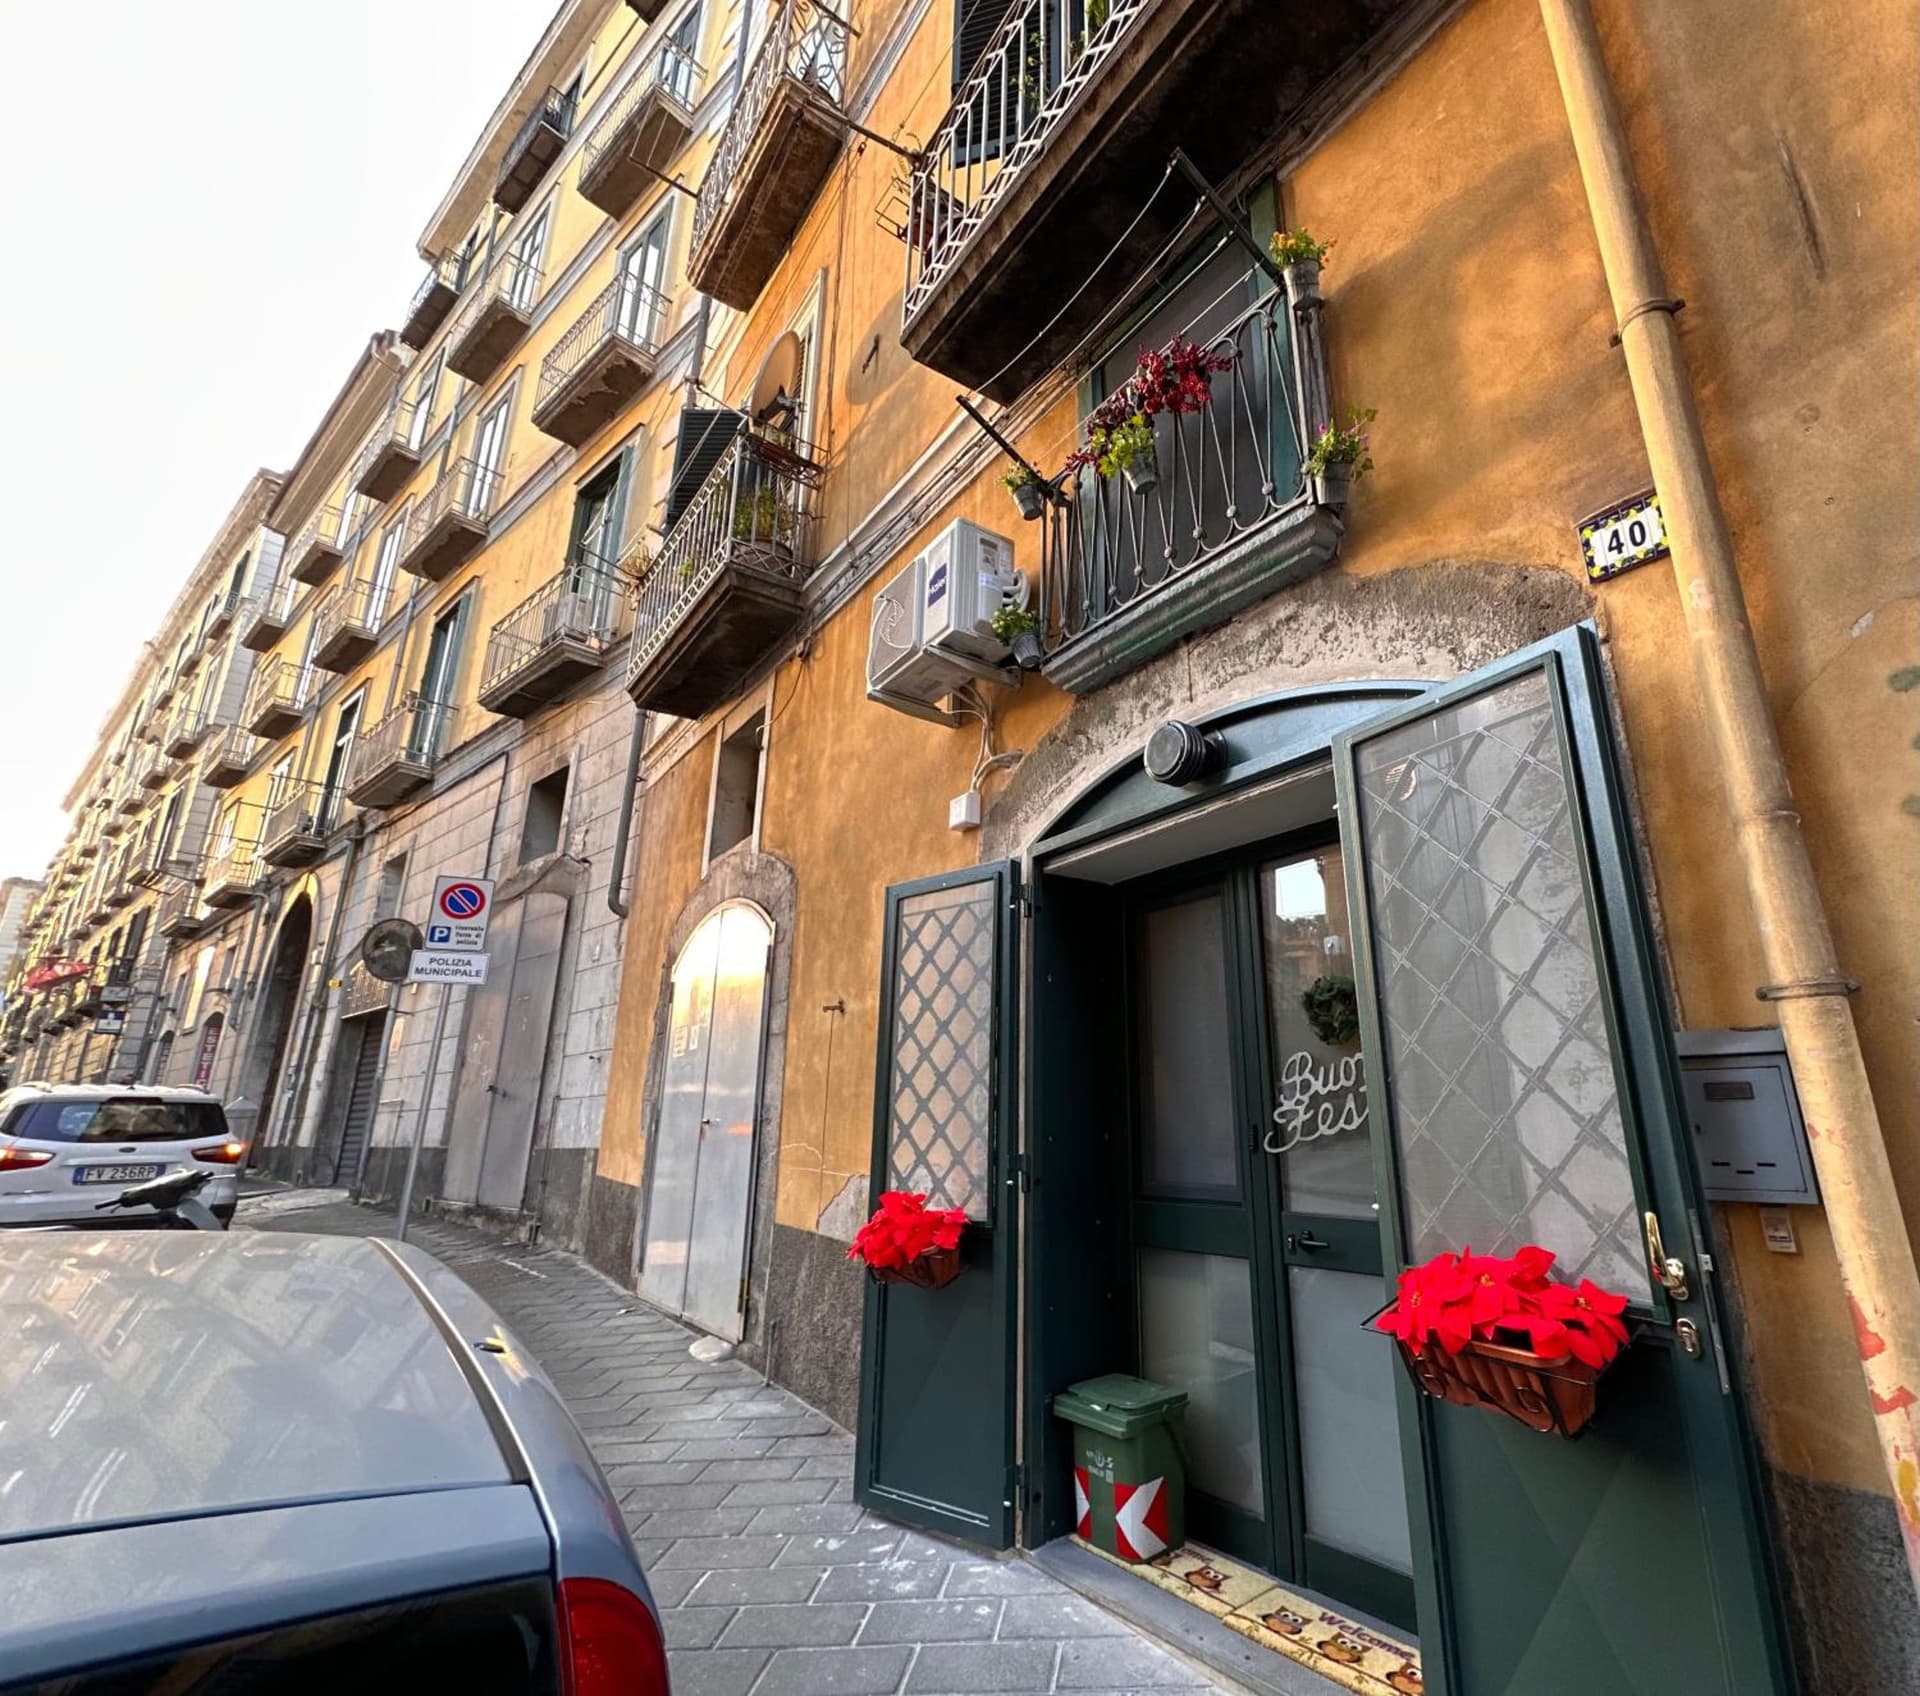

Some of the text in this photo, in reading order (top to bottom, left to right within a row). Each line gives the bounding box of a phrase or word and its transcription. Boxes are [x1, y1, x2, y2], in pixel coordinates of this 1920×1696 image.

[1608, 520, 1647, 555] 40
[433, 927, 449, 941] P
[428, 957, 472, 967] POLIZIA
[414, 967, 484, 978] MUNICIPALE
[1319, 1611, 1416, 1661] Welcome
